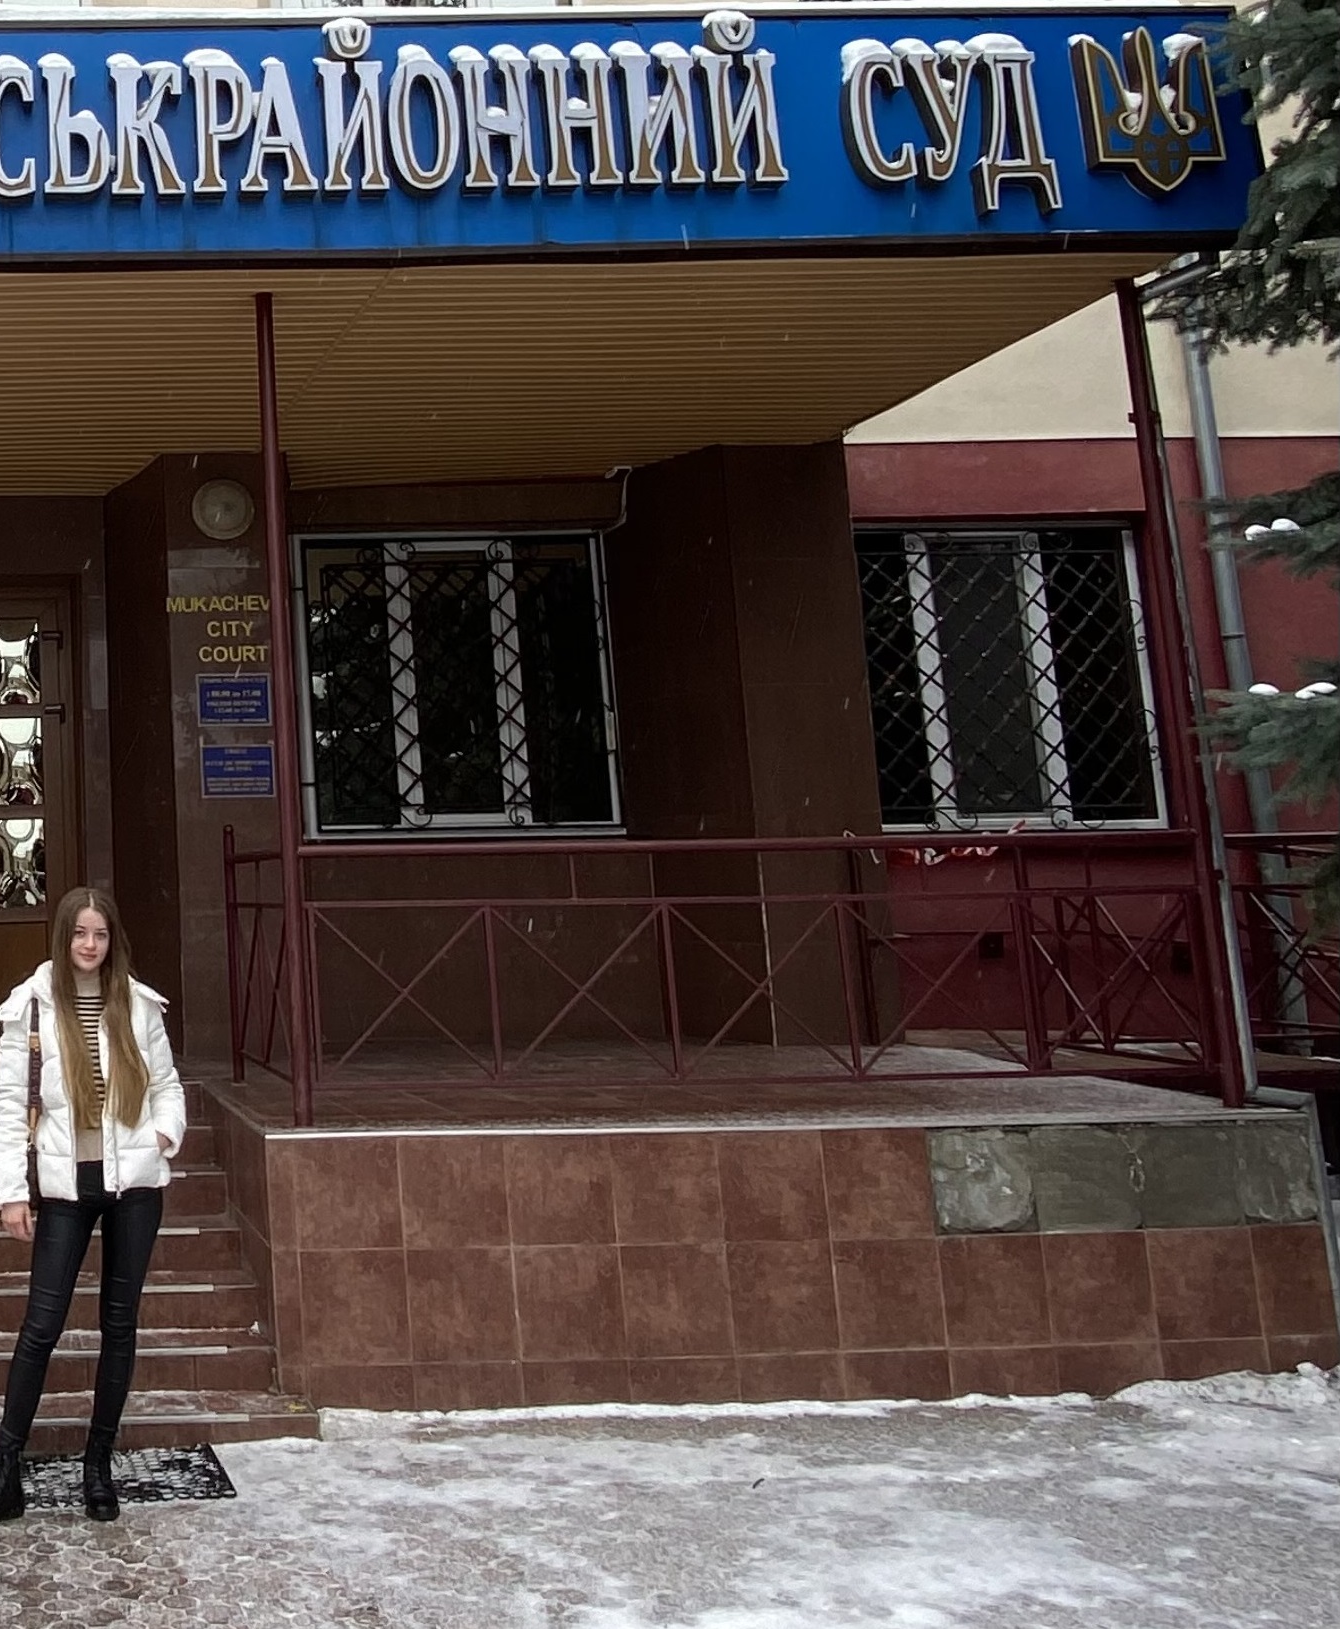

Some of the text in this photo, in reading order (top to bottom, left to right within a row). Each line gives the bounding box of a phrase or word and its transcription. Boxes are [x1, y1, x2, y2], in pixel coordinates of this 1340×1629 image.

[843, 42, 1062, 211] СУД
[166, 595, 288, 613] MUKACHEV
[207, 620, 254, 637] CITY
[199, 645, 268, 662] COURT
